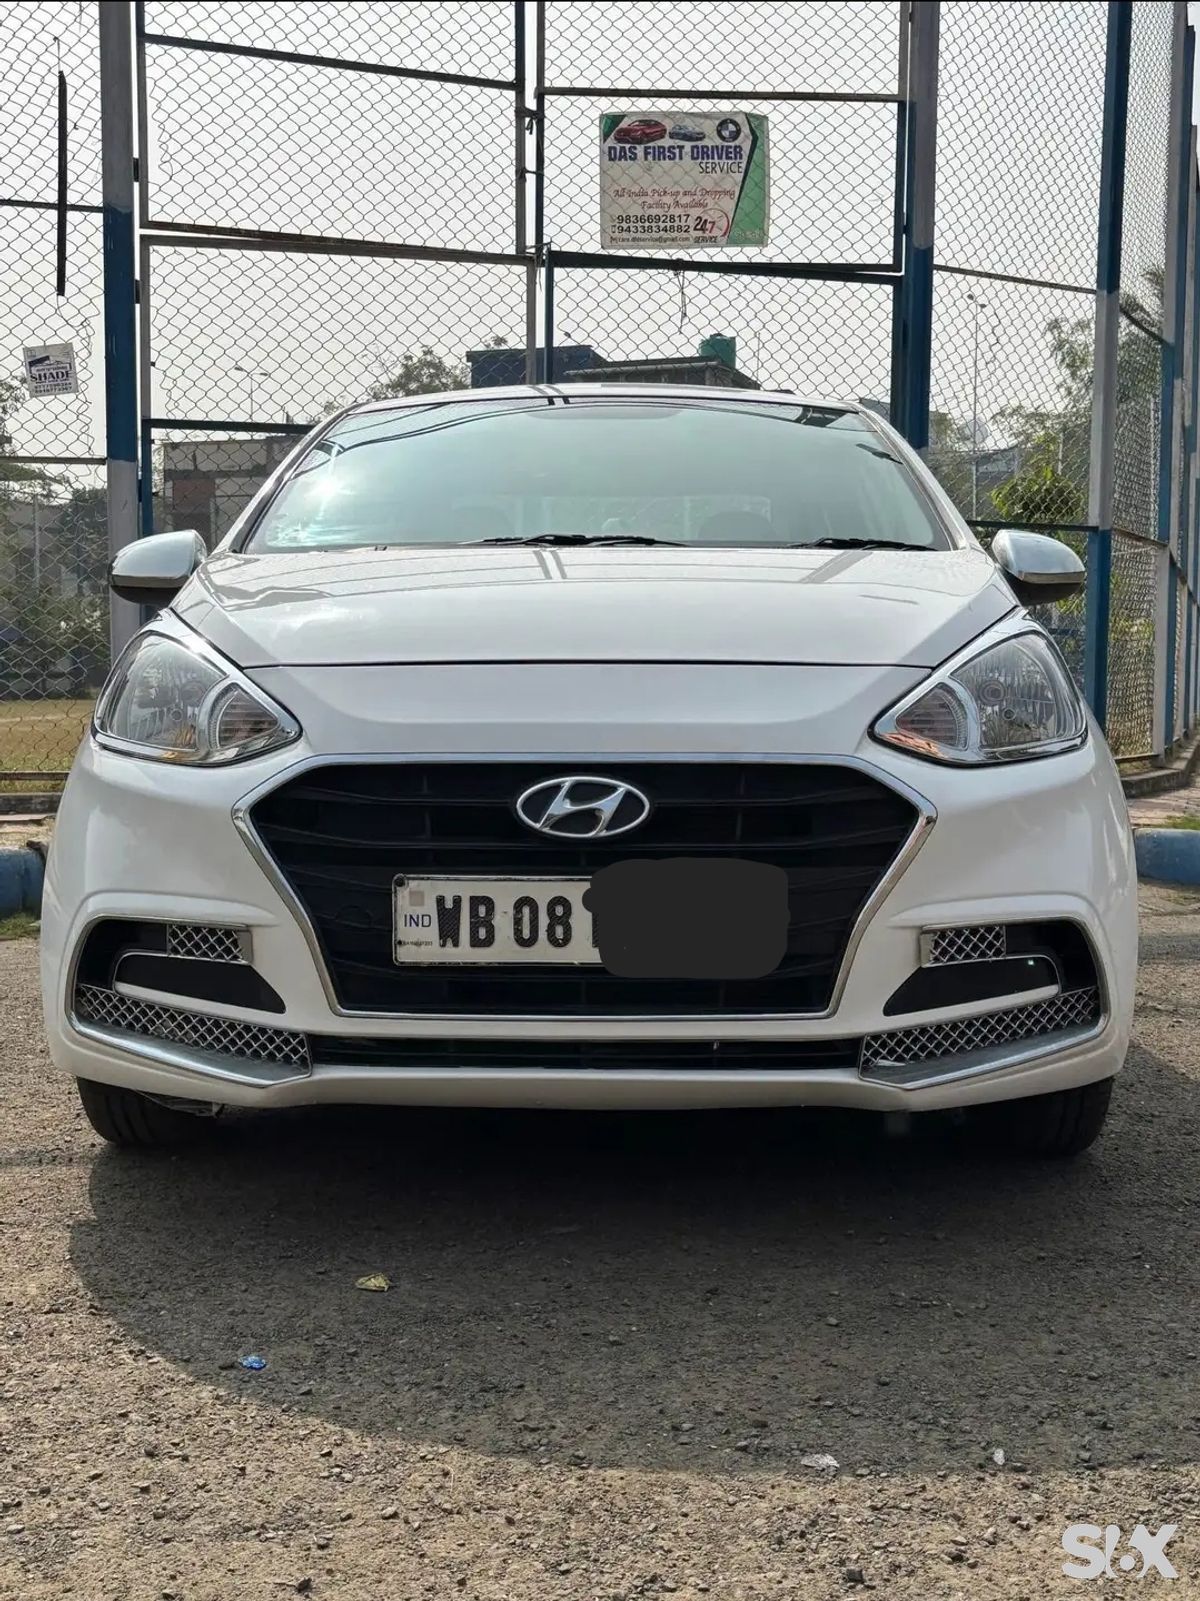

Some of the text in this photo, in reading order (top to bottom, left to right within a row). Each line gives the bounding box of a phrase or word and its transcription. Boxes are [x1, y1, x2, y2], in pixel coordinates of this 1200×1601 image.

[608, 144, 743, 161] DAS FIRST DRIVER
[699, 161, 743, 174] SERVICE
[613, 187, 736, 201] All India Pick-up and Dropping
[641, 199, 709, 212] Facility Available
[616, 213, 691, 224] 9836692817
[617, 224, 691, 234] 9433834882
[404, 914, 432, 928] IND
[436, 895, 495, 948] WB
[513, 895, 573, 948] 08
